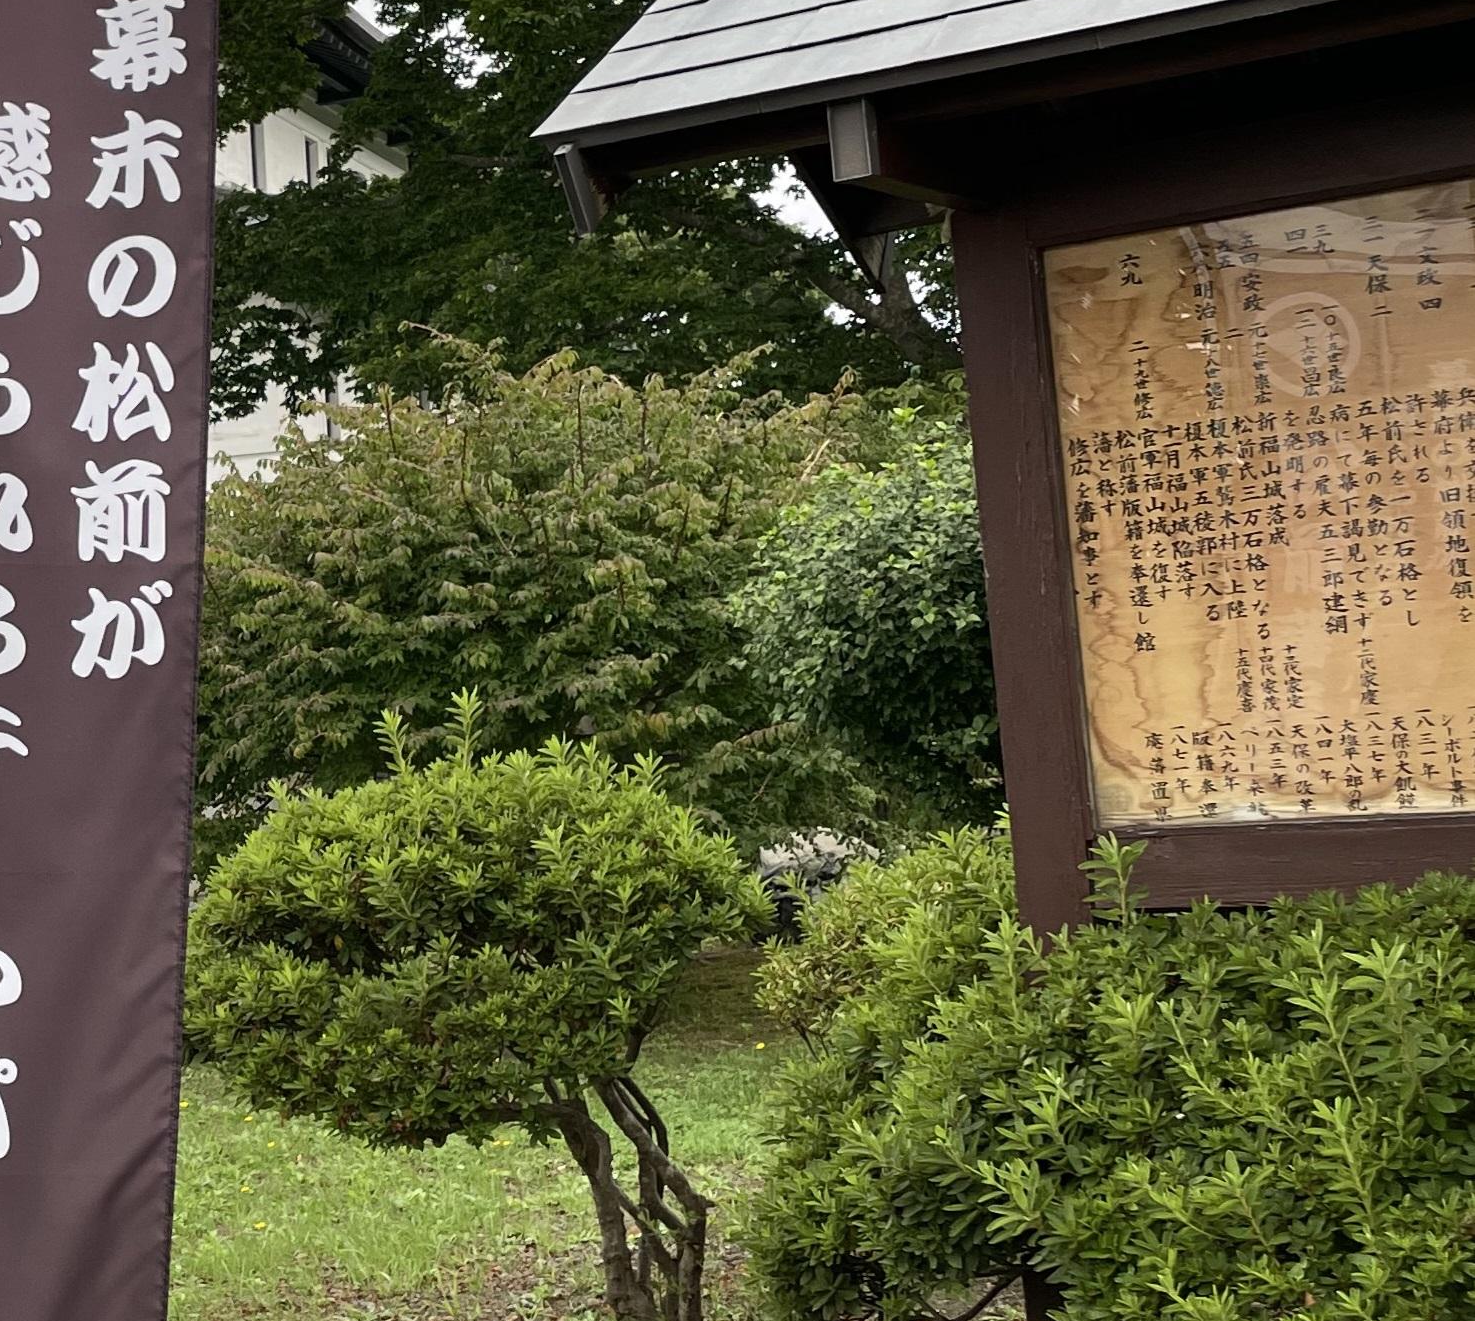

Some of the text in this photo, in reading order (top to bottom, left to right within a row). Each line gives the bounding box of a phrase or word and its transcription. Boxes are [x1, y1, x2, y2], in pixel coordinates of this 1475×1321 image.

[1119, 254, 1143, 286] 六九
[1282, 410, 1307, 520] を発明する
[1405, 393, 1431, 483] 許される
[1137, 428, 1172, 600] 官軍福山城を復す
[1183, 421, 1223, 622] 榎本軍五稜郭に入る
[1231, 415, 1270, 640] 松前氏三万石格となる
[1380, 396, 1423, 627] 松前氏を一万石格とし
[1170, 725, 1192, 793] 一八七一年
[1217, 722, 1240, 792] 一八六九年
[1265, 720, 1287, 789] 一八五三年
[1314, 715, 1337, 784] 一八四一年
[1364, 712, 1387, 783] 一八三七年
[1414, 709, 1441, 781] 一八三一年
